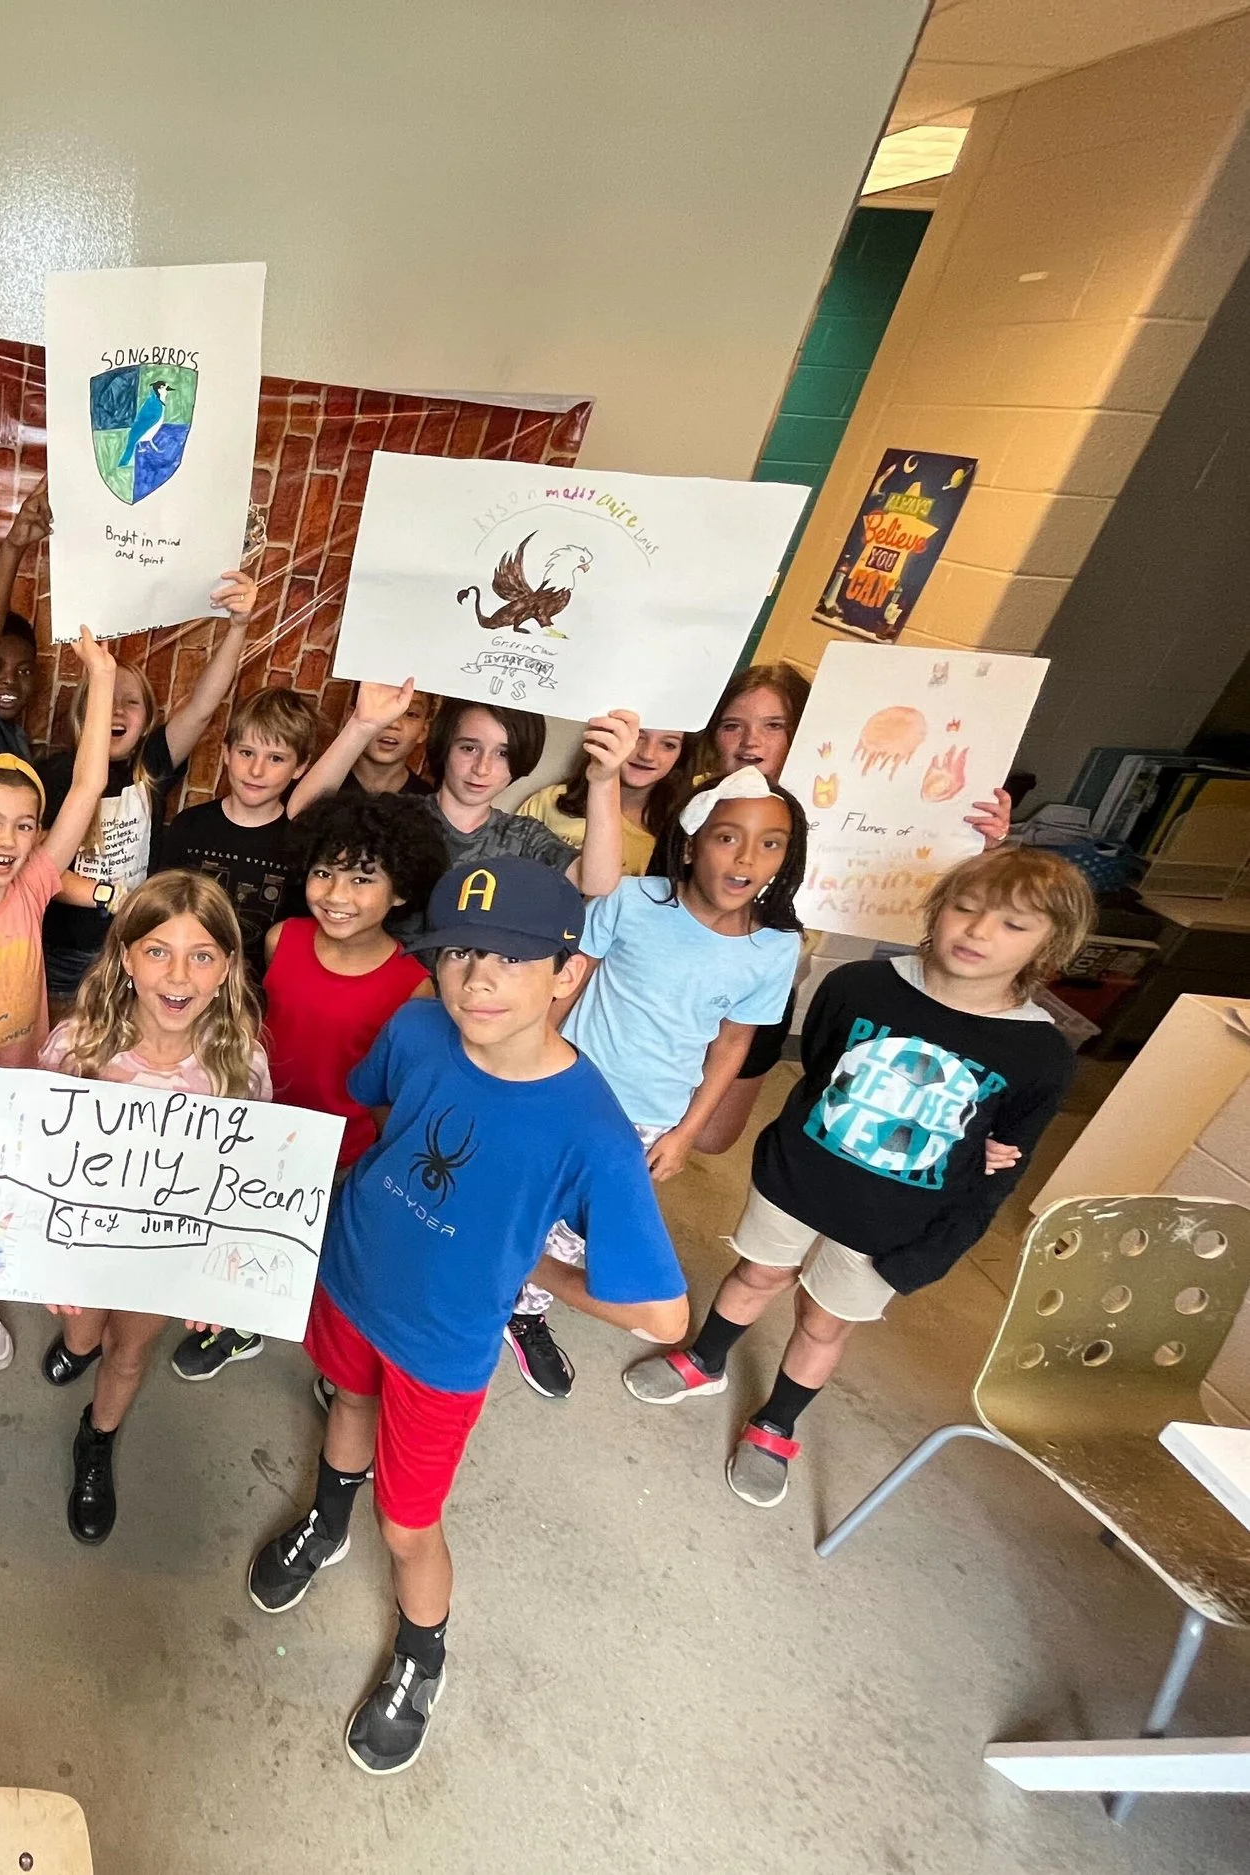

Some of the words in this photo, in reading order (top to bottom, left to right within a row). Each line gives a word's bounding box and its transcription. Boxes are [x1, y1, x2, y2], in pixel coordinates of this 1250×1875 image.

[141, 531, 154, 548] in
[157, 537, 182, 547] mind
[863, 509, 929, 555] Believe
[115, 549, 135, 560] and
[868, 548, 899, 571] YOU
[846, 568, 897, 609] CAN
[841, 811, 888, 836] Flames
[896, 826, 915, 836] of
[104, 833, 140, 851] owerful.
[457, 868, 497, 912] A
[845, 1016, 1008, 1102] PLAYER
[383, 1175, 456, 1238] SPYDER
